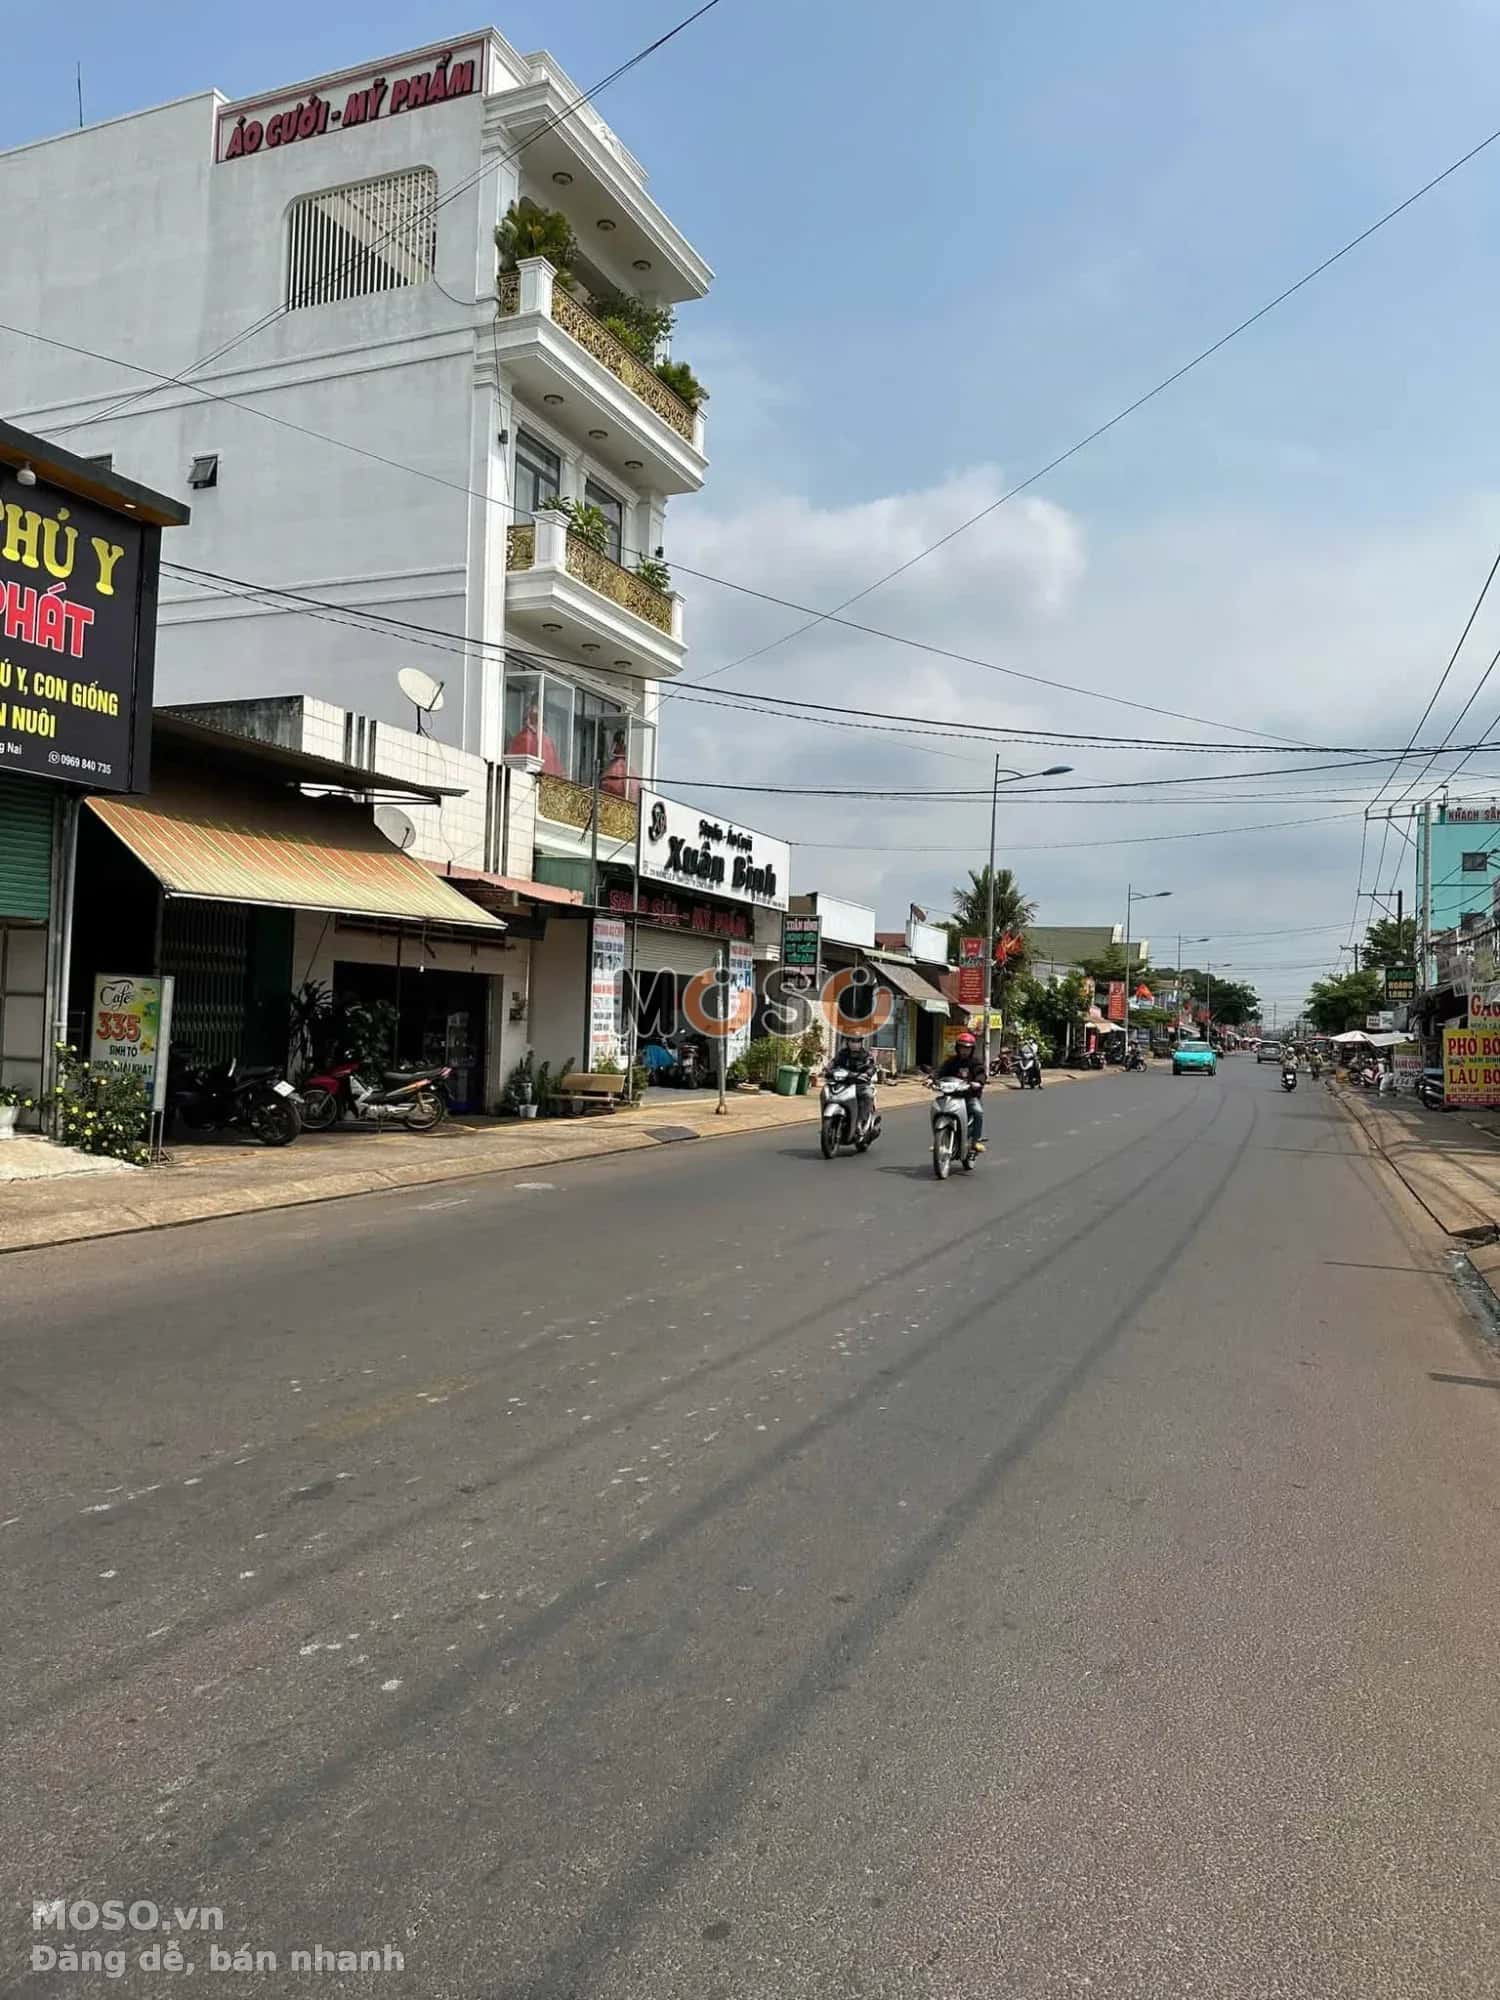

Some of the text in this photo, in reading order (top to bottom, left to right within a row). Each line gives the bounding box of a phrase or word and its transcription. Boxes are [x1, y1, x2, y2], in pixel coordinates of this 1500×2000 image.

[342, 78, 389, 128] MỸ
[390, 51, 475, 114] PHẨM
[91, 536, 125, 596] Y
[16, 666, 28, 696] Y,
[33, 672, 68, 703] CON
[71, 681, 119, 717] GIỐNG
[12, 705, 56, 738] NUÔI
[7, 741, 22, 755] Nai
[60, 753, 80, 768] 0969
[81, 758, 96, 773] 840
[97, 761, 112, 775] 735
[664, 835, 726, 883] Xuân
[731, 853, 777, 898] Bình
[96, 1011, 142, 1042] 335
